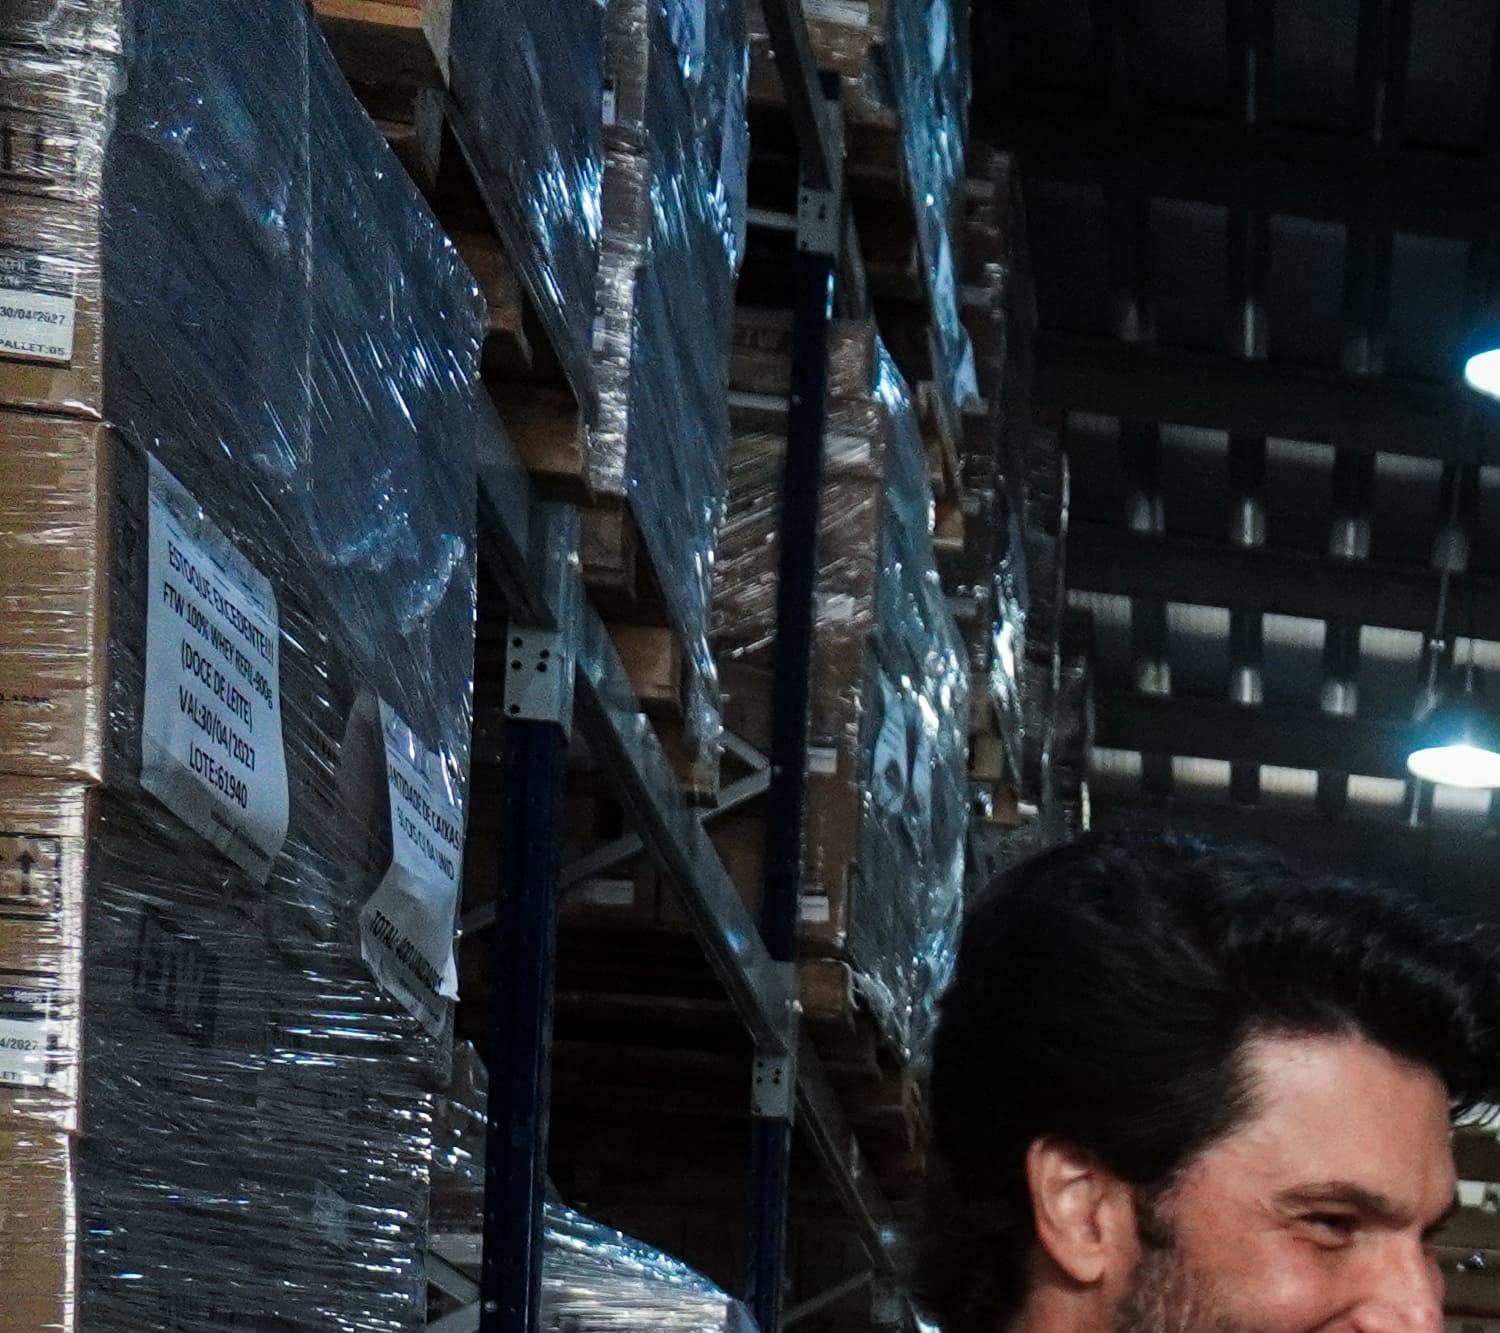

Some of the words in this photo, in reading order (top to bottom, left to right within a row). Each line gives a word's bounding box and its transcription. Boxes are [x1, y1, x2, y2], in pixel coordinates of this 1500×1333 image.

[167, 540, 212, 602] ESTOQUE
[163, 582, 184, 617] FTW
[186, 602, 209, 638] 100%
[210, 628, 234, 667] WHEY
[181, 638, 213, 688] (DOCE
[213, 676, 225, 704] DE
[224, 681, 254, 732] LEITE)
[189, 740, 248, 809] LOTE:61940
